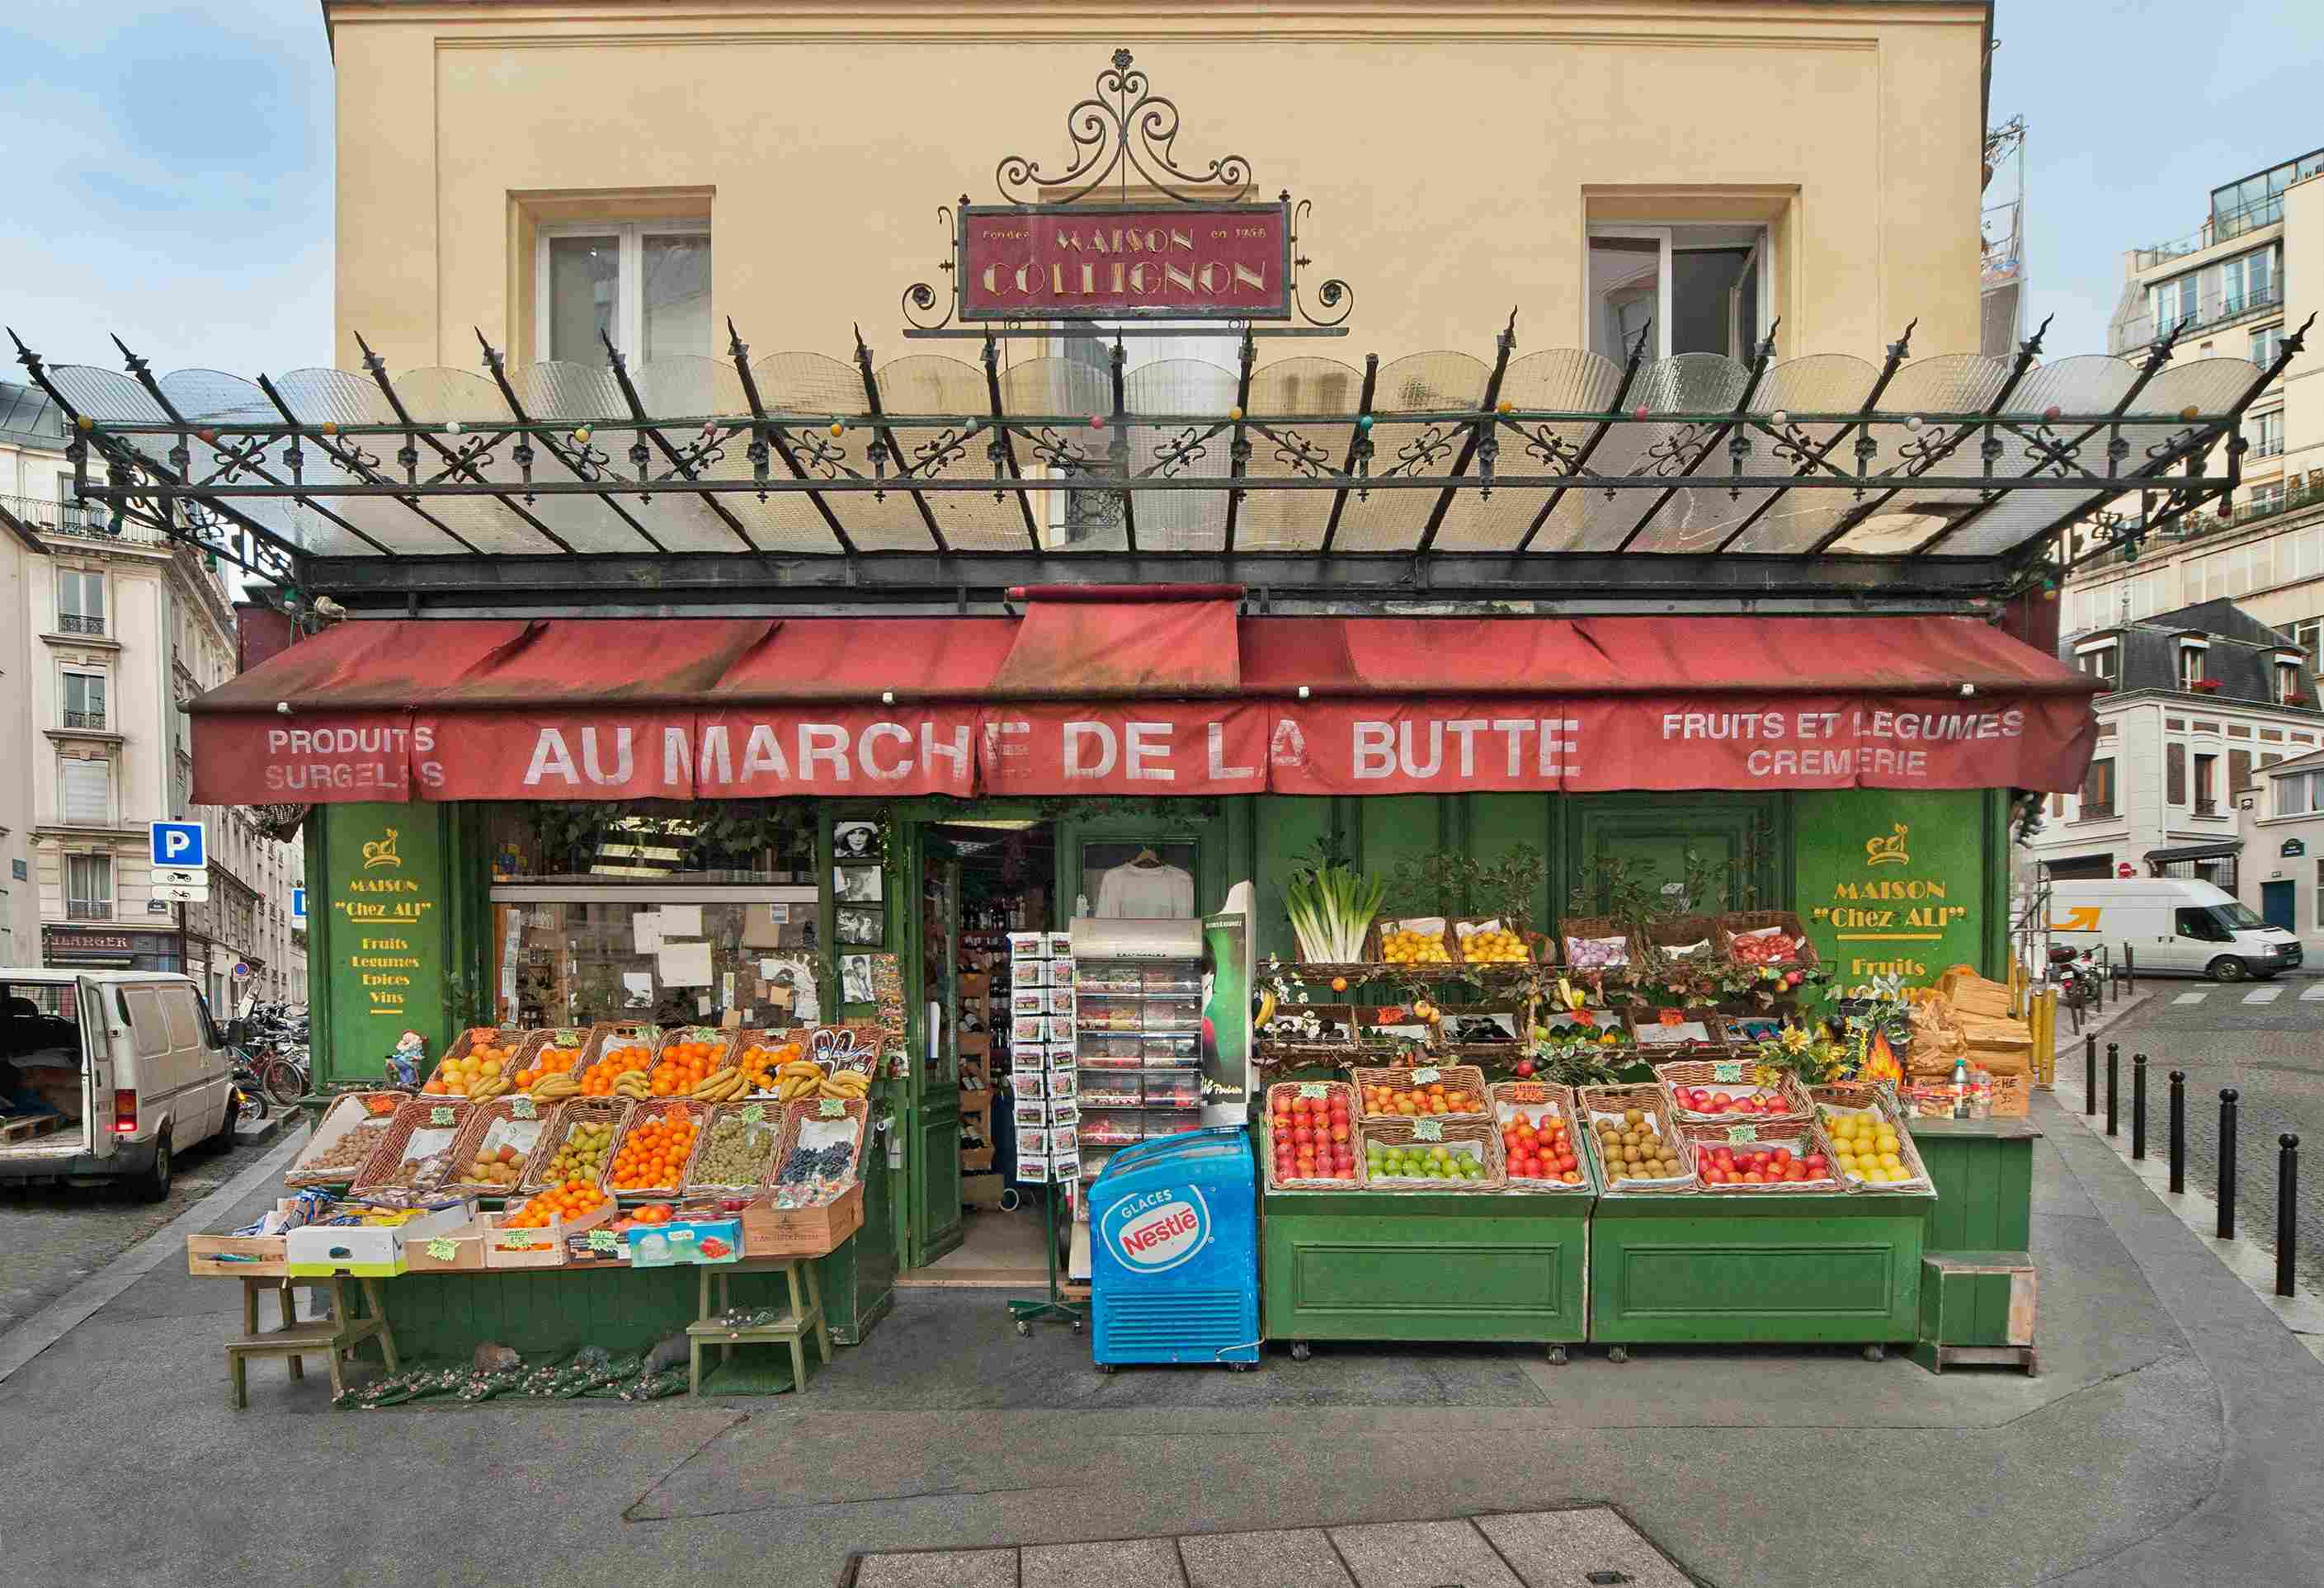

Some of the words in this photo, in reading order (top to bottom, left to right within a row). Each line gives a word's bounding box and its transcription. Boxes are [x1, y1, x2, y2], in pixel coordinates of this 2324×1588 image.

[1055, 228, 1195, 253] MAISON
[983, 261, 1268, 297] COLLIGNON
[1662, 712, 1786, 740] FRUITS
[1797, 712, 1842, 740] ET
[1852, 710, 2026, 741] LEGUMES
[268, 726, 436, 754] PRODUITS
[523, 727, 633, 785] AU
[1062, 720, 1176, 780] DE
[1207, 719, 1313, 780] LA
[1352, 719, 1582, 780] BUTTE
[1747, 747, 1929, 777] CREMERIE
[166, 830, 191, 859] P
[349, 879, 418, 893] MAISON
[1834, 879, 1947, 900] MAISON
[362, 937, 408, 950] Fruits
[362, 973, 410, 987] Epices
[1851, 958, 1926, 977] Fruits
[370, 991, 404, 1004] Vins
[1121, 1189, 1173, 1219] GLACES
[1121, 1207, 1199, 1256] Nestlé
